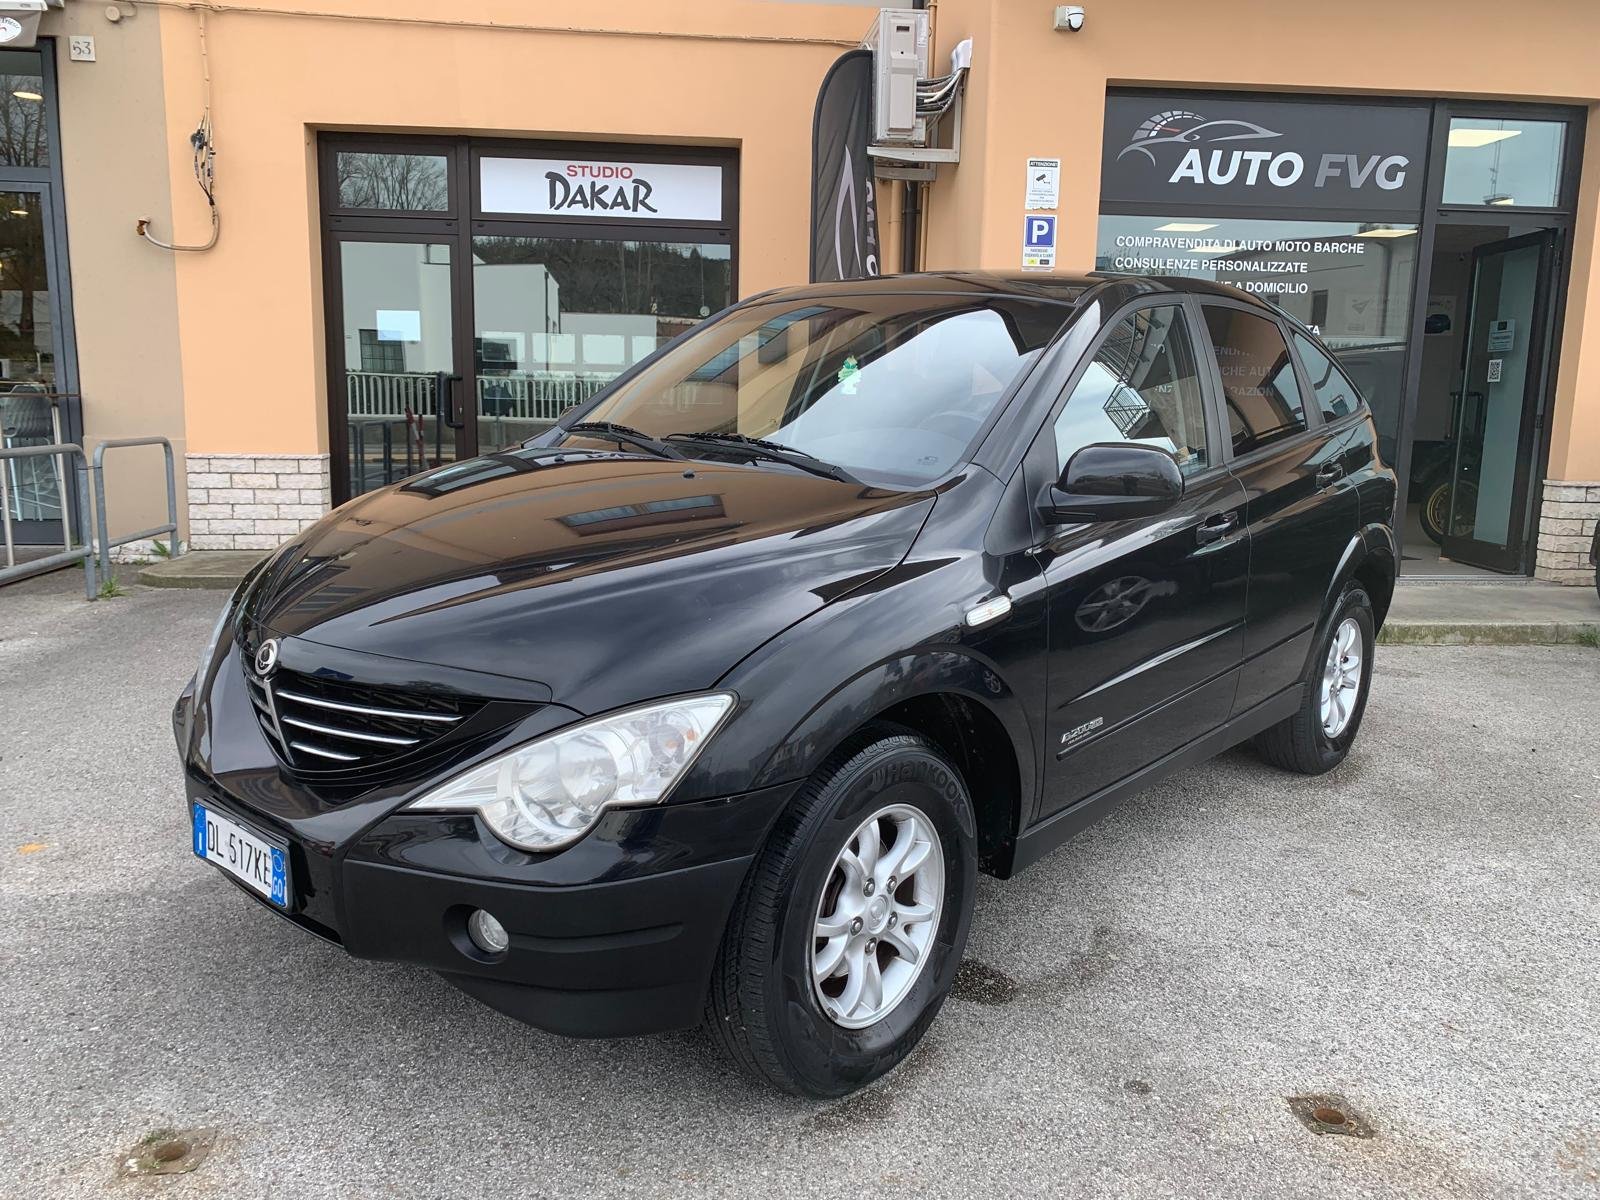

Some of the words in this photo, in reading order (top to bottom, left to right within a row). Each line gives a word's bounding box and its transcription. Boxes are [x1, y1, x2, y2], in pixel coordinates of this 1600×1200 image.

[566, 164, 633, 180] STUDIO
[1168, 148, 1305, 187] AUTO
[1314, 153, 1410, 191] FVG
[544, 171, 658, 214] DAKAR
[1032, 220, 1049, 243] P
[1116, 236, 1219, 250] COMPRAVENDITA
[1224, 238, 1235, 251] DI
[1239, 239, 1273, 252] AUTO
[1275, 241, 1311, 253] MOTO
[1314, 242, 1365, 254] BARCHE
[1115, 257, 1198, 271] CONSULENZE
[1201, 259, 1308, 273] PERSONALIZZATE
[1235, 281, 1243, 289] A
[1246, 281, 1308, 294] DOMICILIO
[207, 820, 224, 858] DL
[229, 833, 272, 888] 517KE
[272, 876, 283, 898] GO
